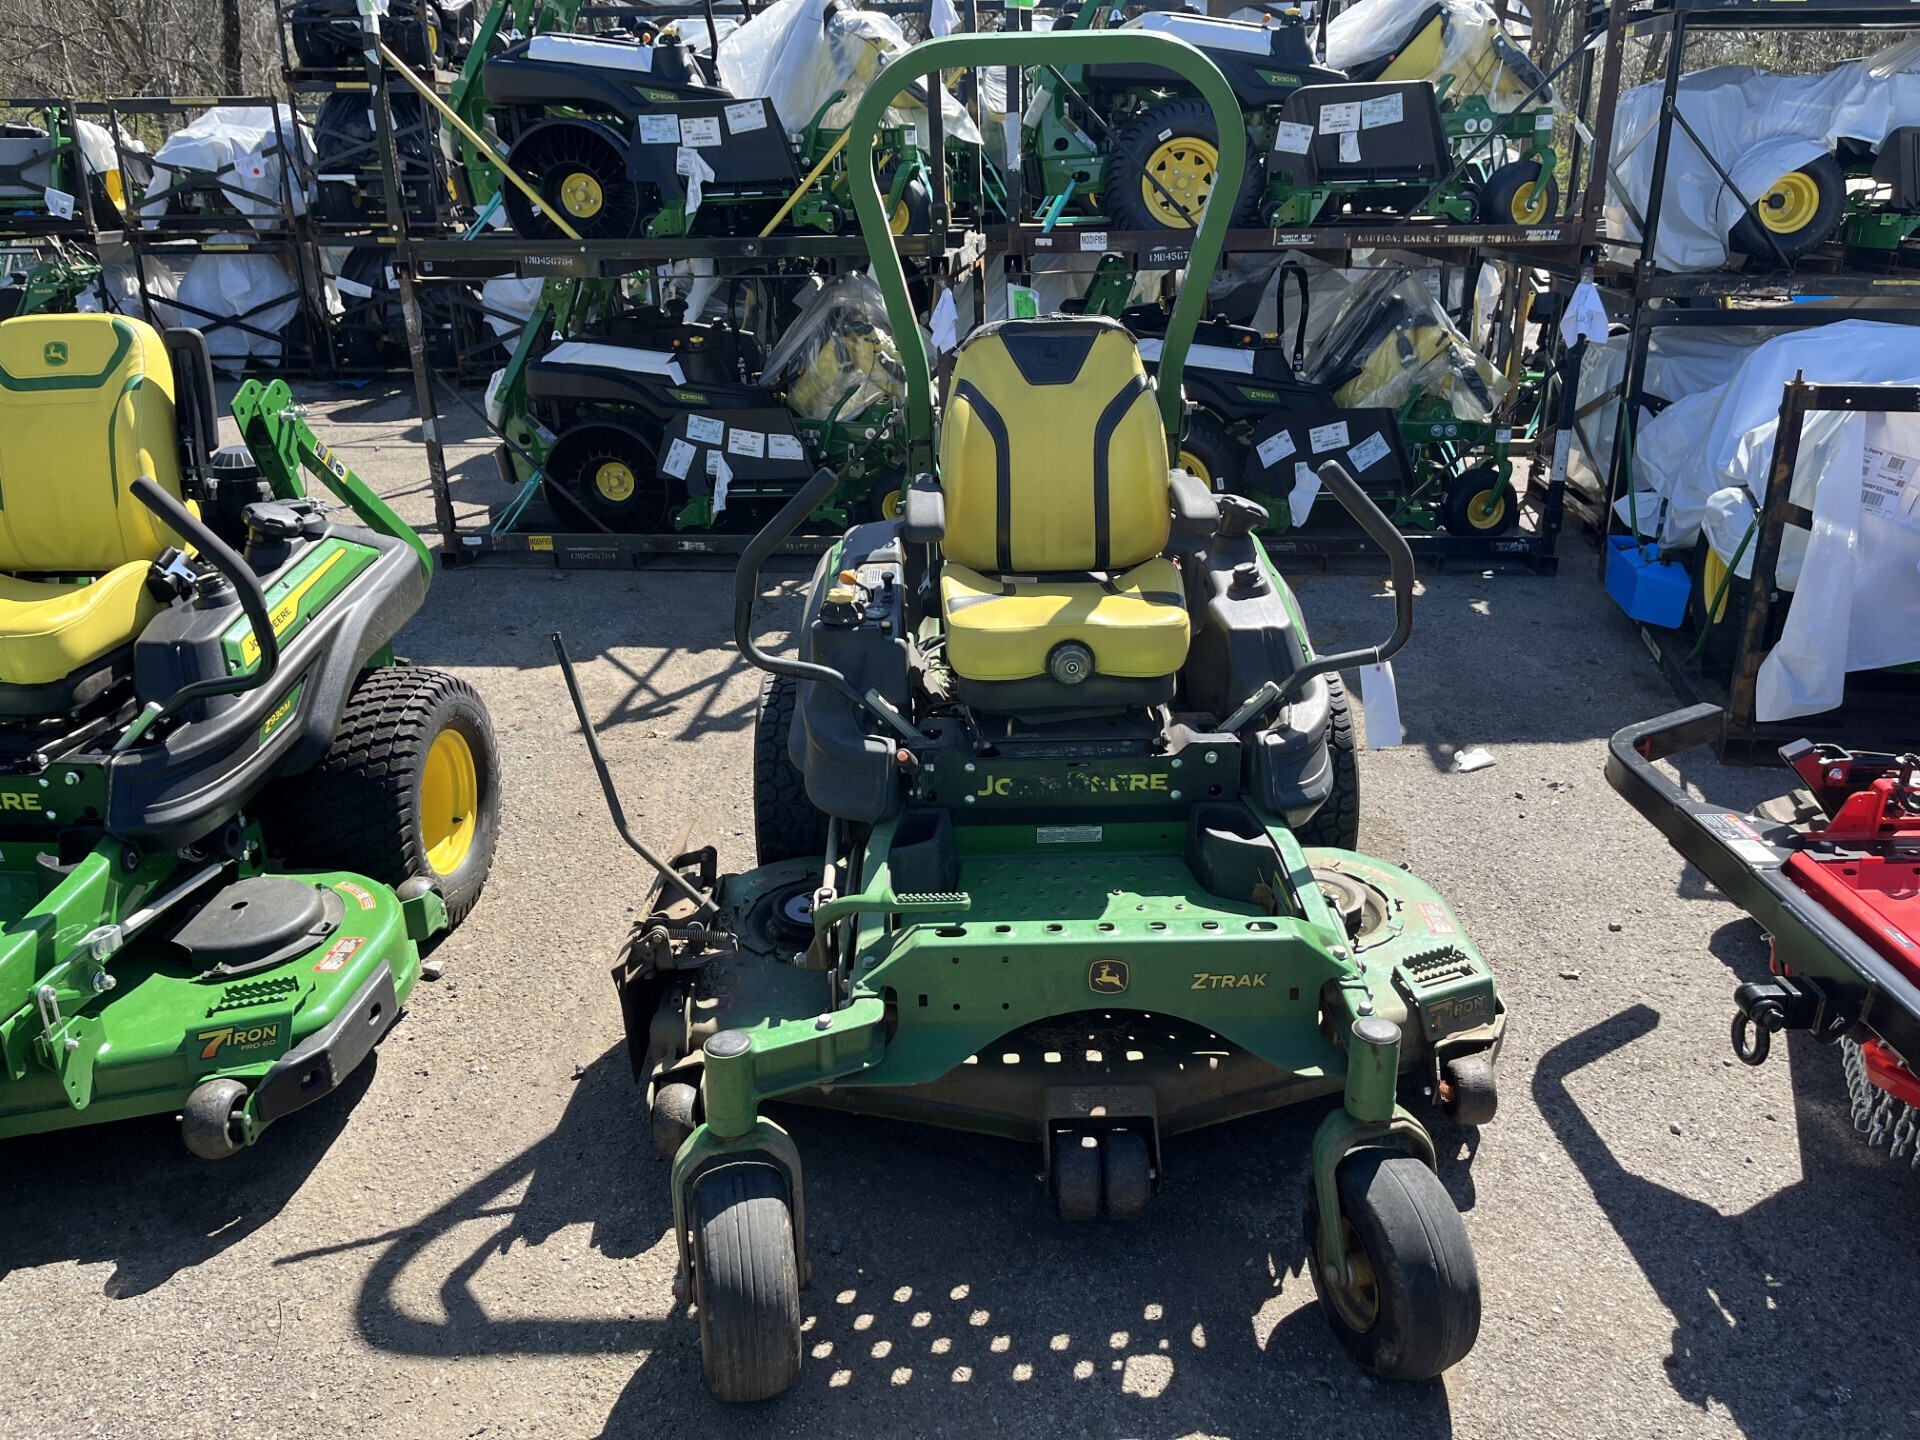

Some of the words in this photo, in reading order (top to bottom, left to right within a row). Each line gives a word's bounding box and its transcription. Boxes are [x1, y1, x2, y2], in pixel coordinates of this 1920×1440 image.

[1081, 235, 1107, 245] MODIFIED
[1447, 234, 1485, 243] BEFORE
[264, 699, 291, 734] Z930M
[0, 792, 42, 811] RE
[1191, 973, 1268, 990] ZTRAK
[241, 1042, 260, 1052] PRO
[262, 1039, 276, 1047] 60
